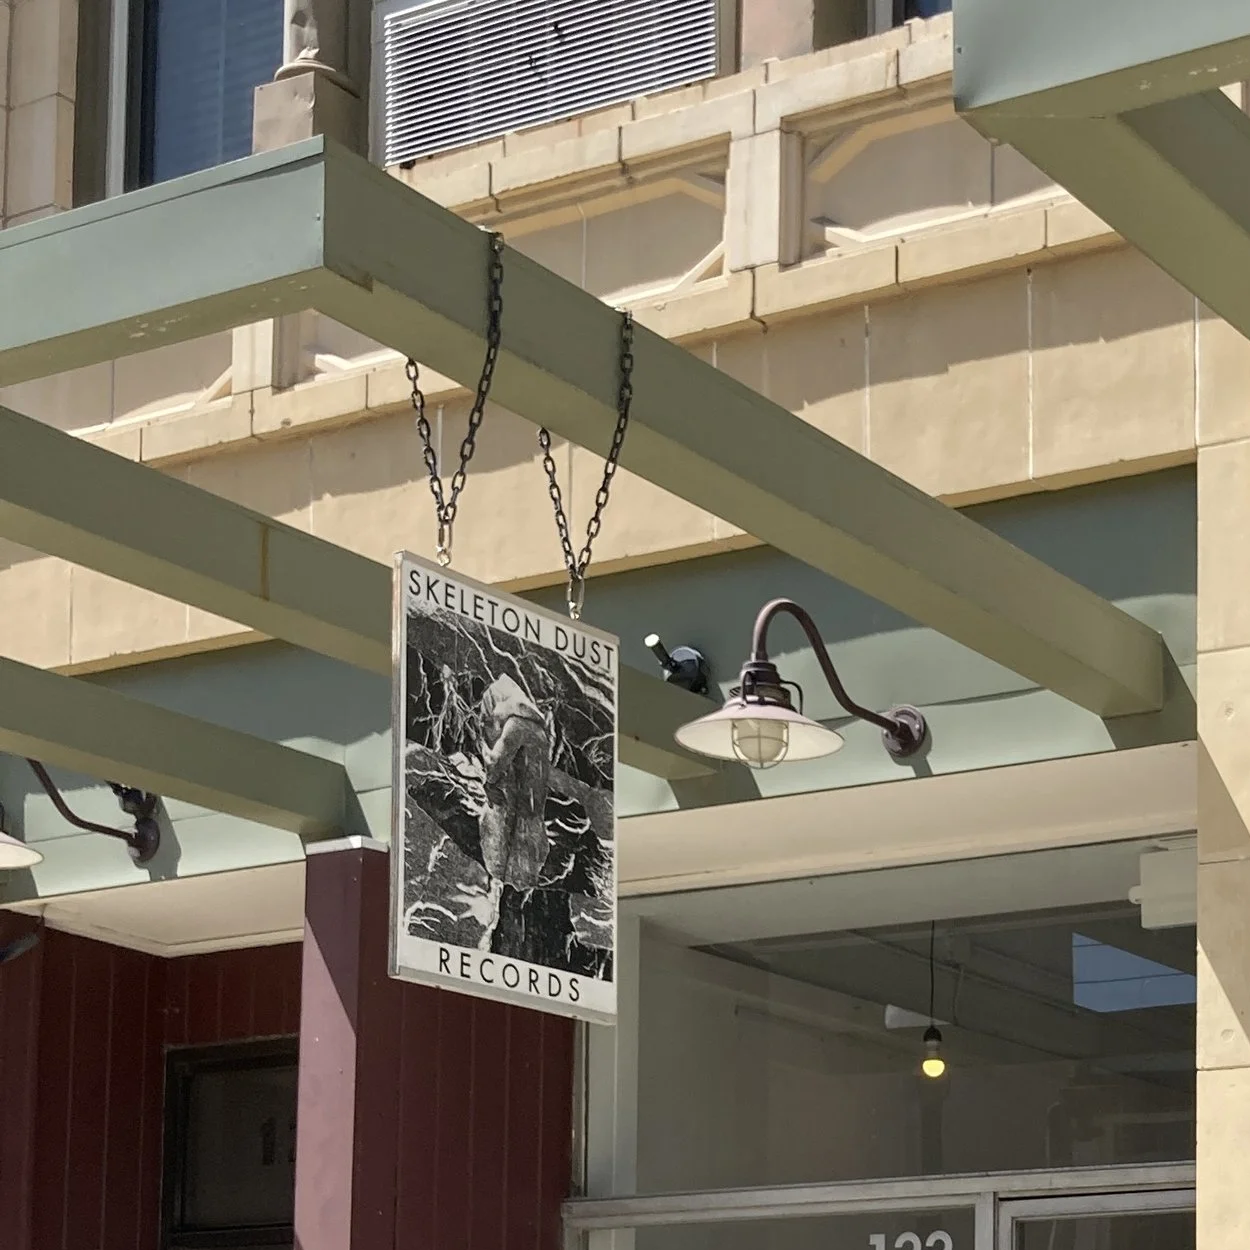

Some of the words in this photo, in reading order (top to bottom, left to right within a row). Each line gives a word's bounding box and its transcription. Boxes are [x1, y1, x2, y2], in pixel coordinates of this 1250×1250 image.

[408, 569, 542, 645] SKELETON
[555, 624, 615, 671] DUST
[438, 946, 582, 1003] RECORDS
